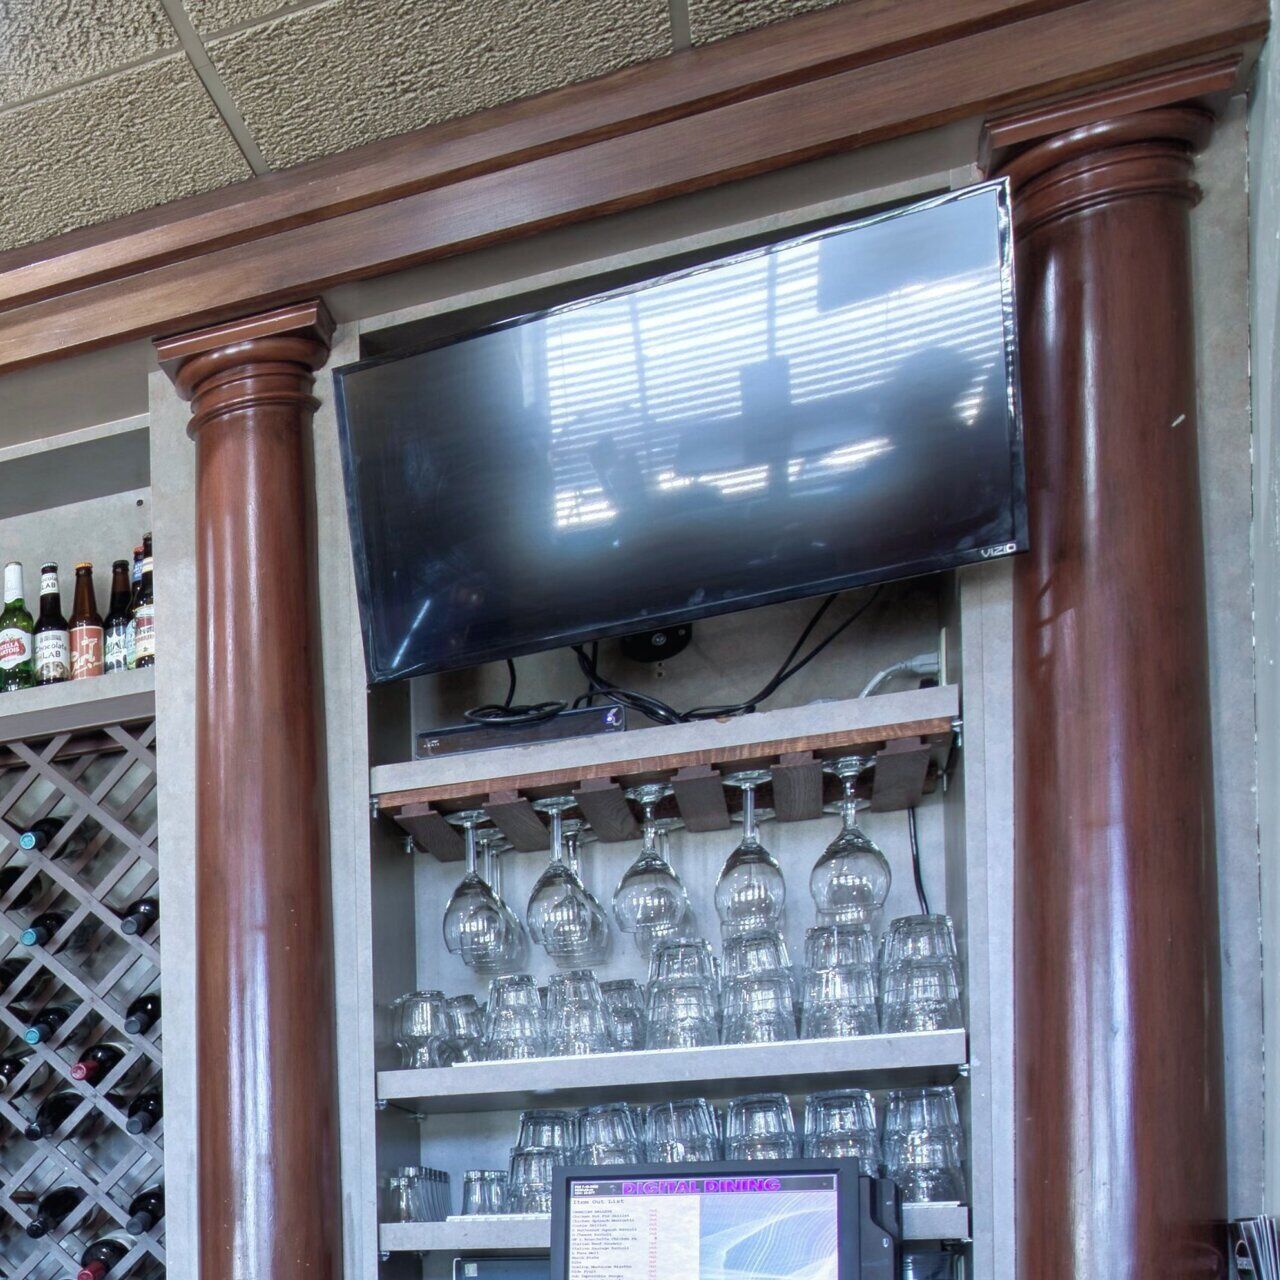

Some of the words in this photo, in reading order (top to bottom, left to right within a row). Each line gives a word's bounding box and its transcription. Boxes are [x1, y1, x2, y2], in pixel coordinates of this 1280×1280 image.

[981, 543, 1016, 557] VIZIO
[622, 1180, 701, 1195] DIGITAL
[704, 1178, 781, 1193] DINING
